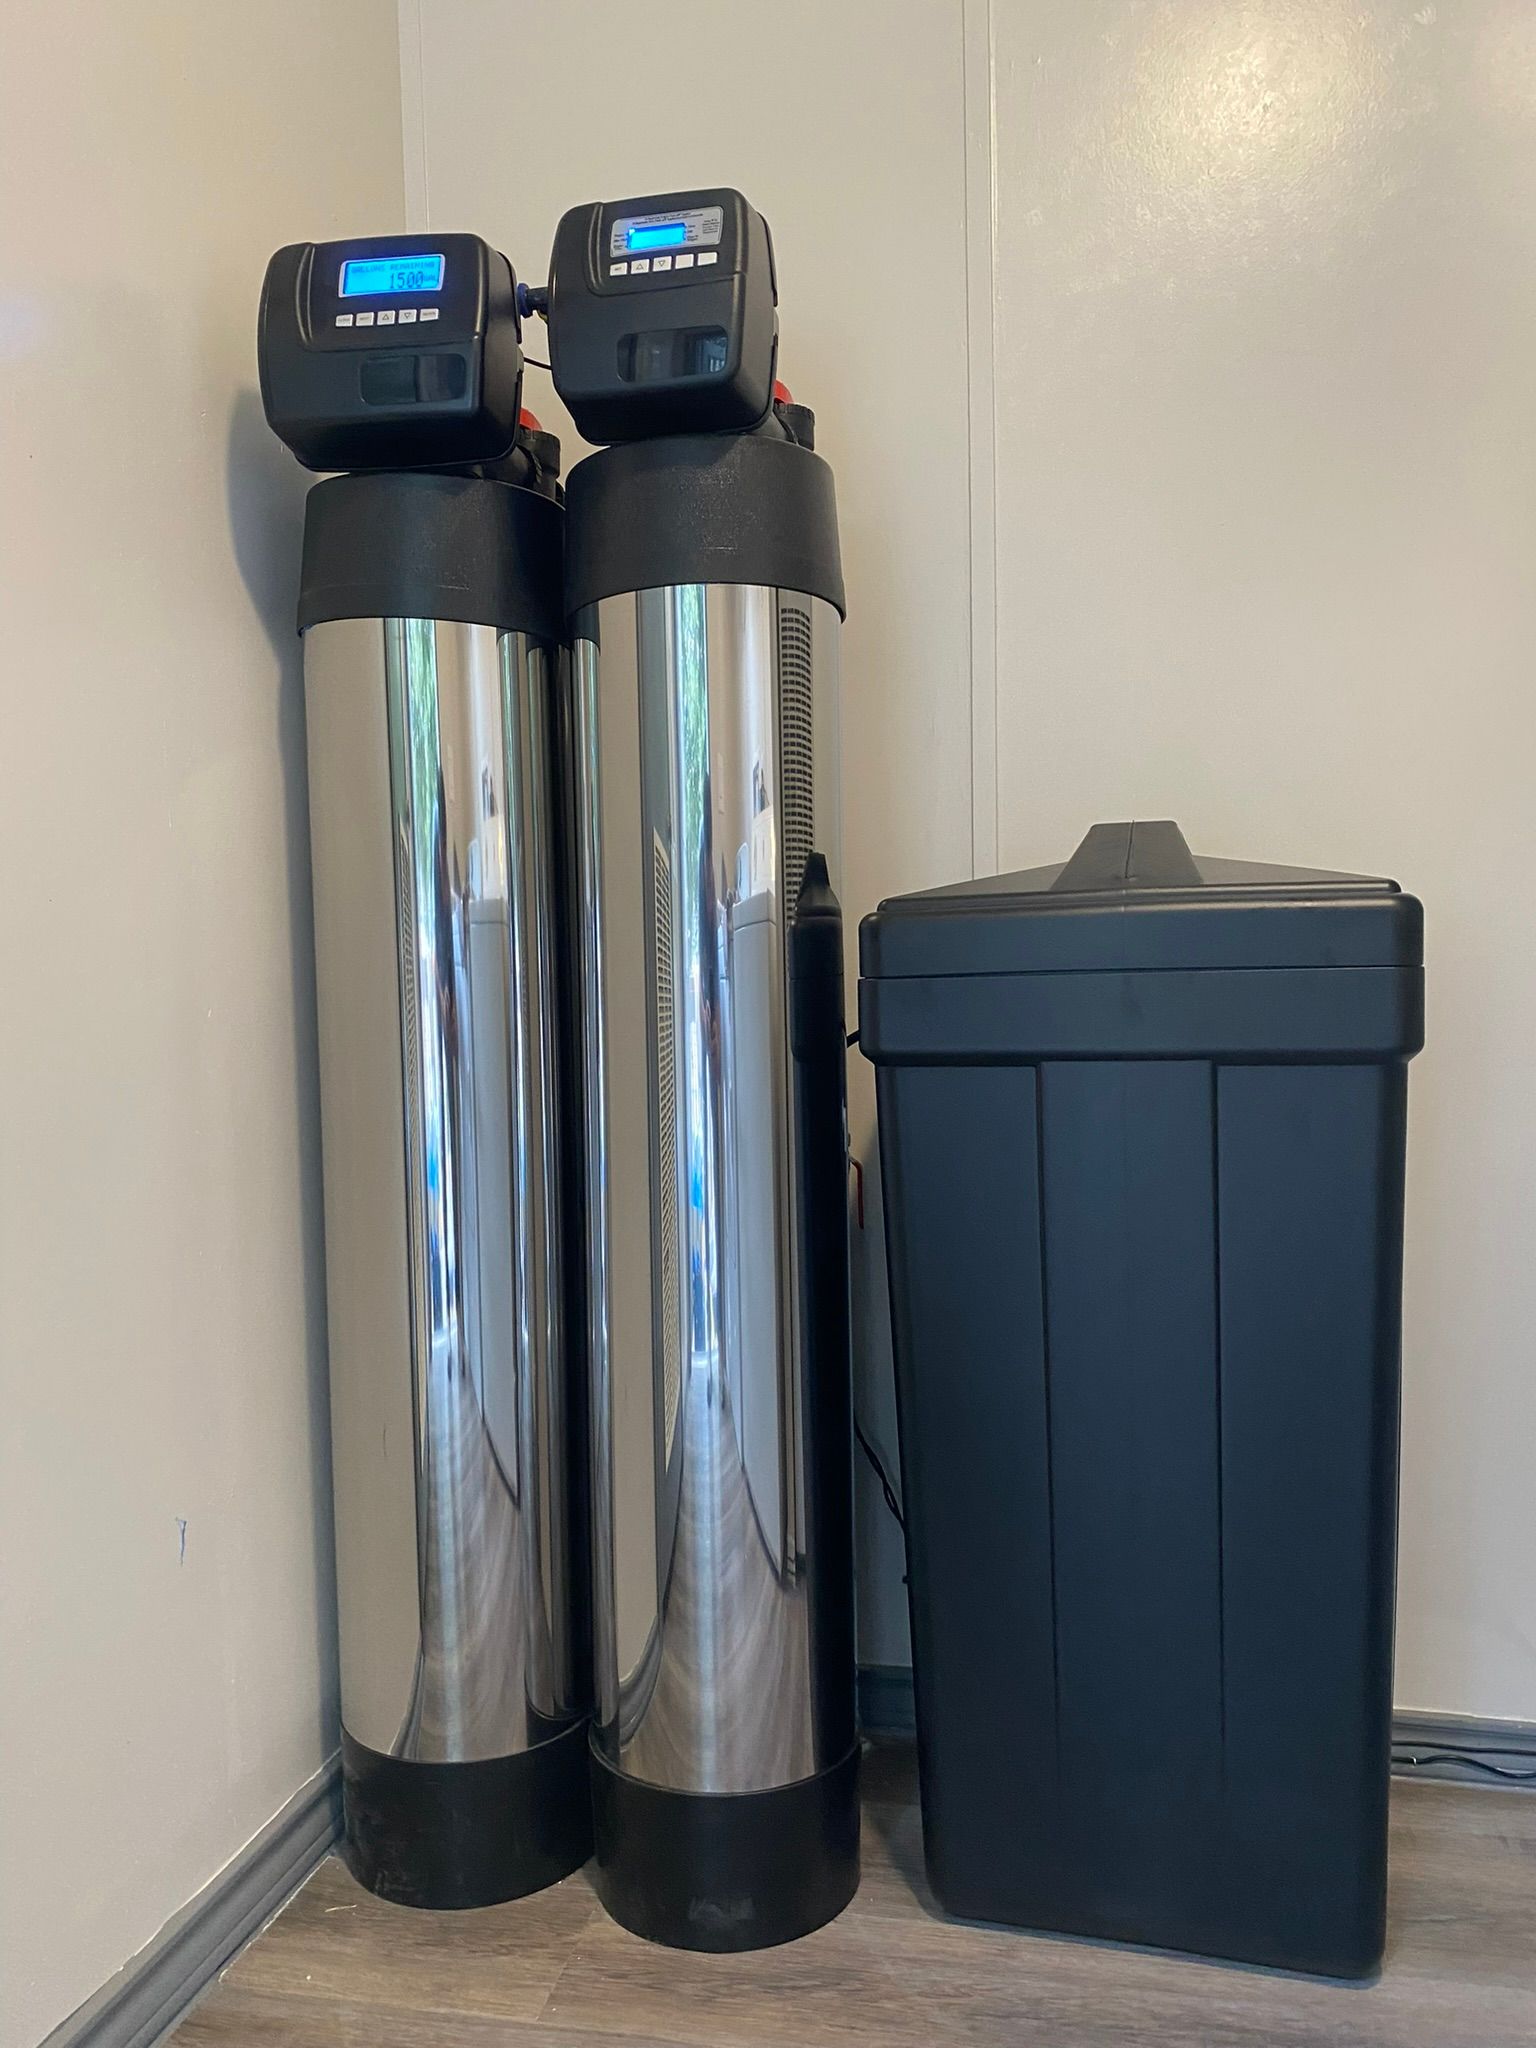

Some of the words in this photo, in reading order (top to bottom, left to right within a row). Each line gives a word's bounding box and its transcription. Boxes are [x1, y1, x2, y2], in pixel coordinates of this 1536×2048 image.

[351, 263, 385, 273] LLONS
[390, 261, 434, 270] REMAINI
[390, 271, 423, 289] 1500
